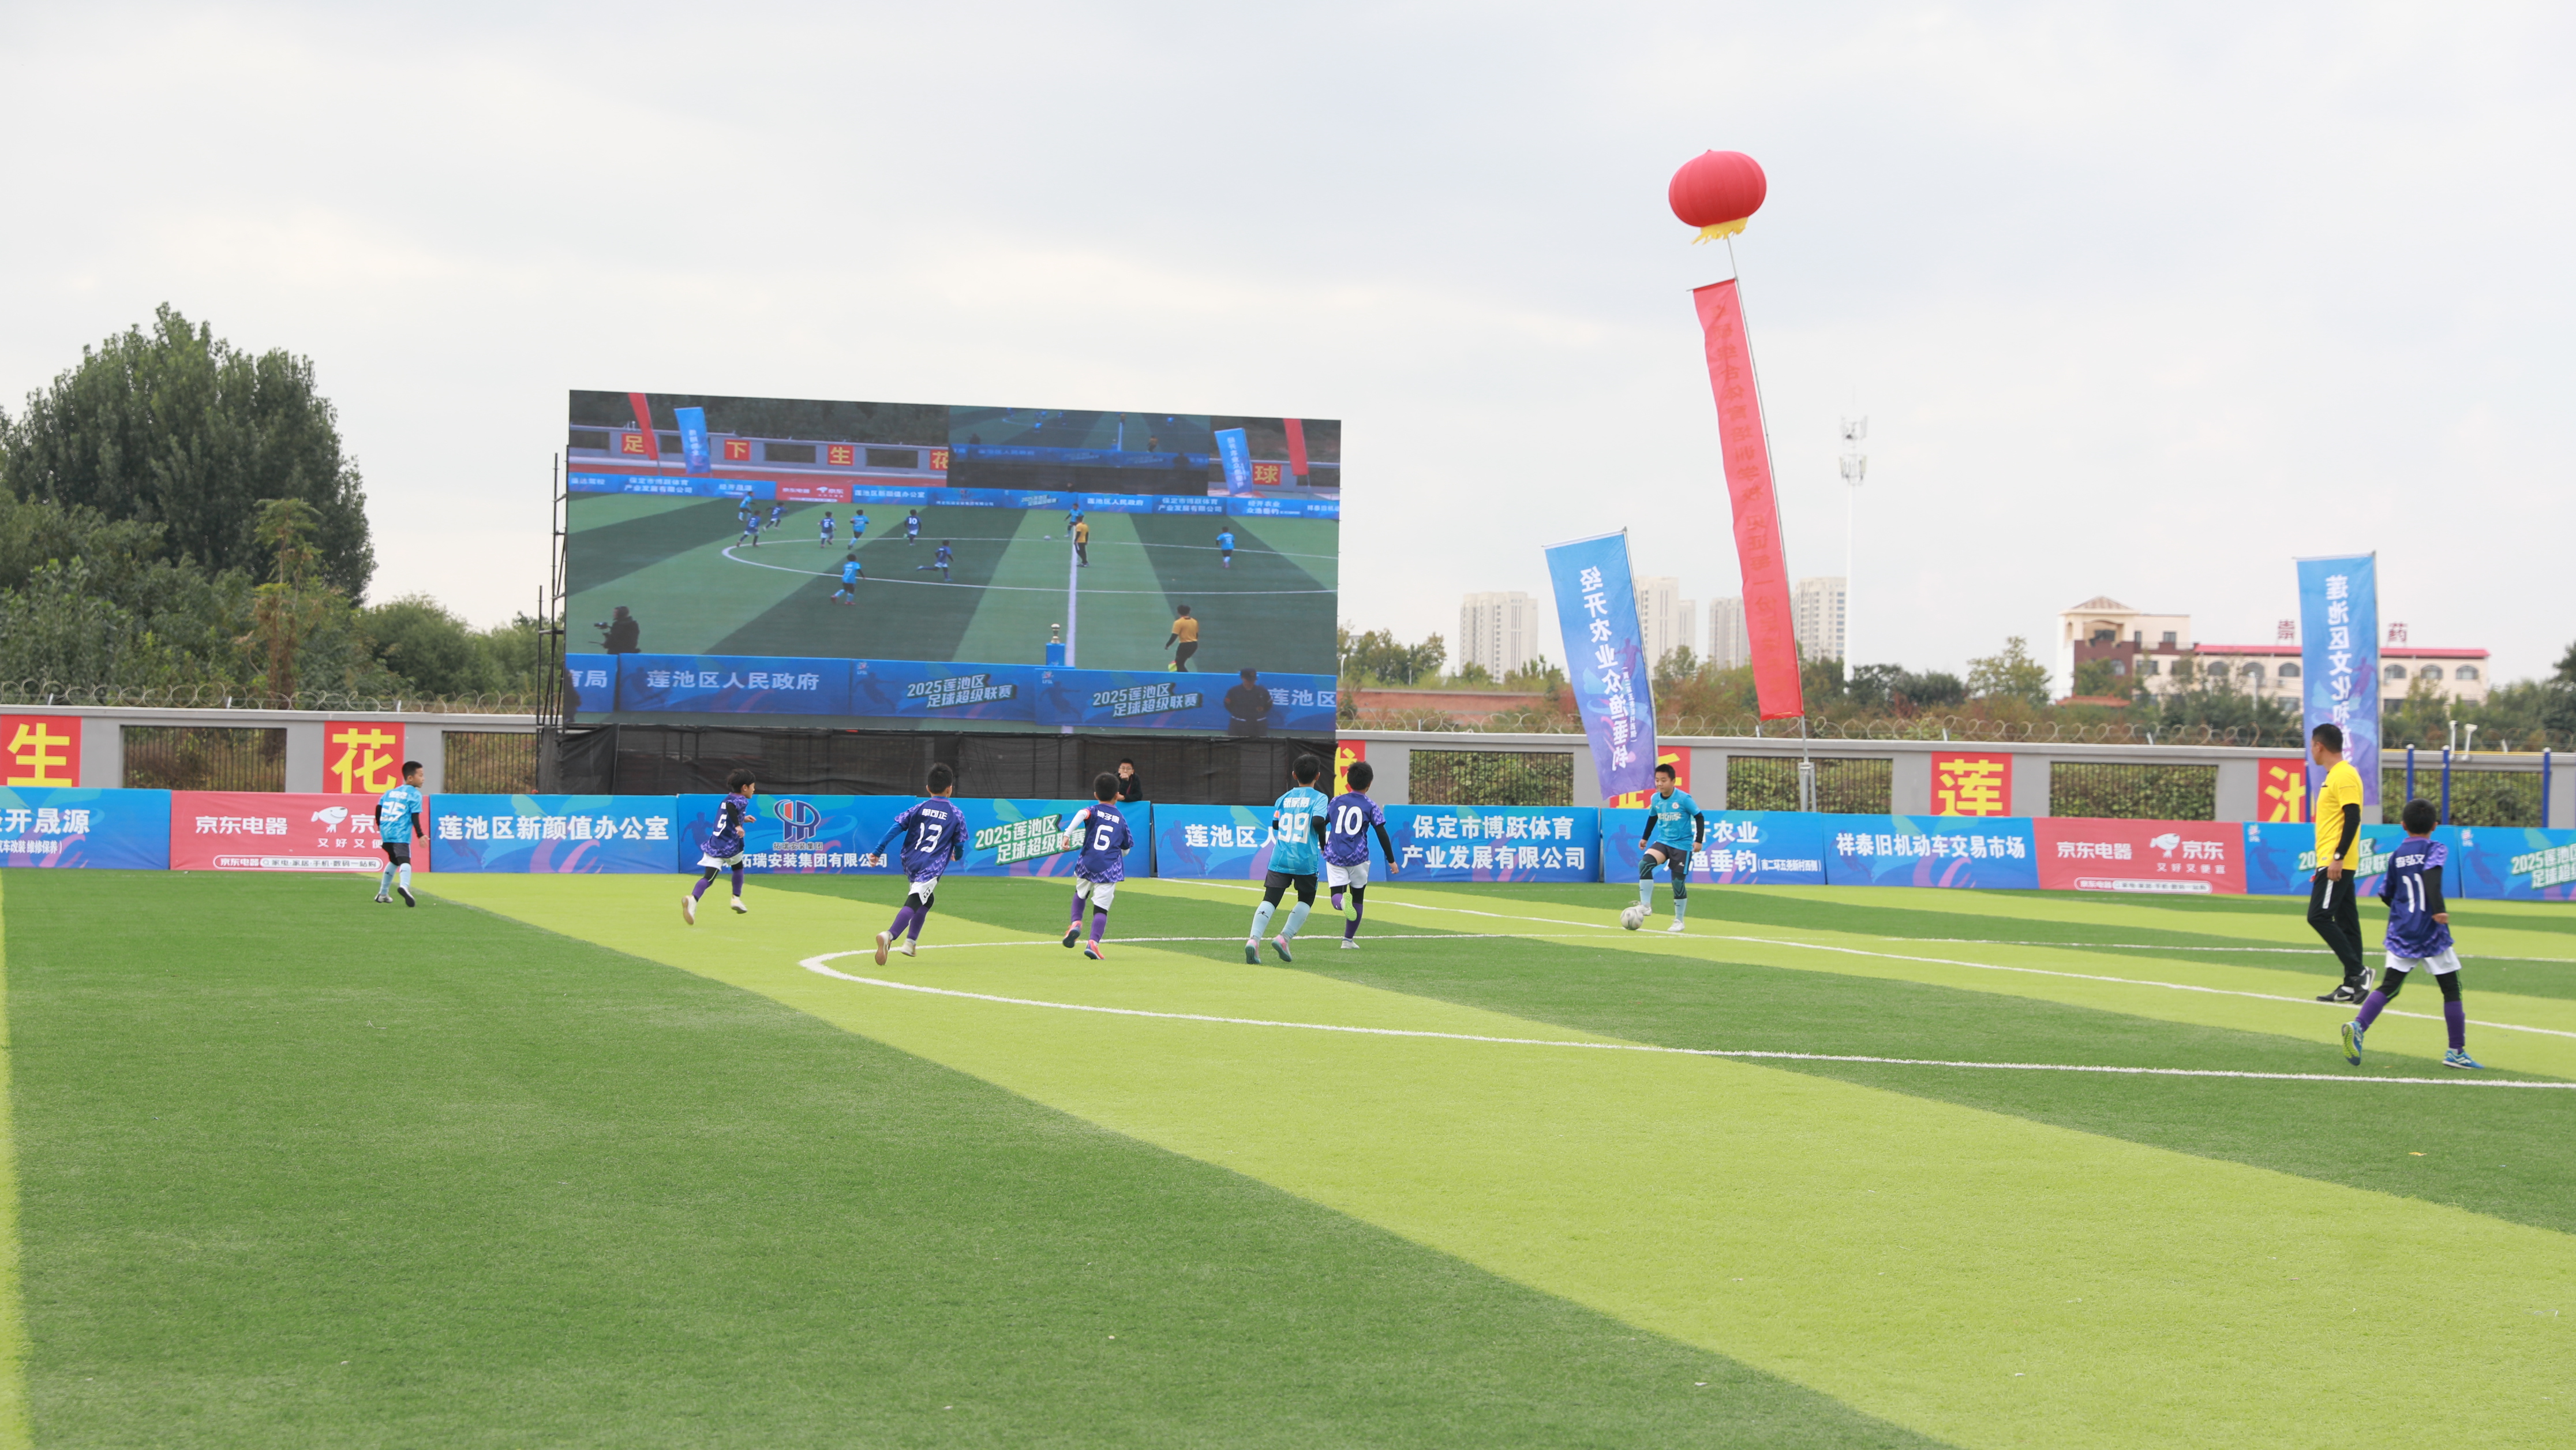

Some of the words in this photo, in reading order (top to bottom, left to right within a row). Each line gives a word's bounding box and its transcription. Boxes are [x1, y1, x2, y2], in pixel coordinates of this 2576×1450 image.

[624, 435, 645, 453] 足
[727, 442, 747, 458] 下
[829, 446, 851, 465] 生
[1255, 465, 1278, 483] 球
[647, 670, 819, 690] 莲池区人民政府
[907, 674, 986, 697] 2025莲池区
[927, 685, 1013, 708] 足球超级联赛
[1092, 683, 1171, 705] 2025莲池区
[1113, 693, 1198, 717] 足球超级联赛
[1268, 687, 1336, 707] 莲池区
[7, 723, 73, 787] 生
[331, 727, 398, 793] 花
[1938, 758, 2004, 816] 莲
[0, 808, 90, 834] 开晟源
[195, 816, 287, 835] 京东电器
[351, 814, 378, 834] 京
[439, 815, 669, 841] 莲池区新颜值办公室
[975, 814, 1058, 848] 2025莲池区
[1278, 813, 1310, 844] 99
[1335, 805, 1363, 835] 10
[1413, 814, 1574, 840] 保定市博跃体育
[317, 838, 383, 849] 又好又便
[773, 842, 823, 851] 拓瑞安装集团
[915, 823, 943, 853] 13
[1093, 824, 1114, 851] 6
[1836, 832, 2025, 859] 祥泰旧机动车交易市场
[220, 858, 259, 866] 京东电器
[723, 853, 888, 868] 拓瑞安装集团有限公司
[1401, 844, 1586, 870] 产业发展有限公司
[1663, 849, 1757, 873] 渔垂钓
[2057, 842, 2132, 859] 京东电器
[2182, 840, 2224, 860] 京东
[2156, 862, 2226, 875] 又好又便宜
[2402, 873, 2425, 913] 11
